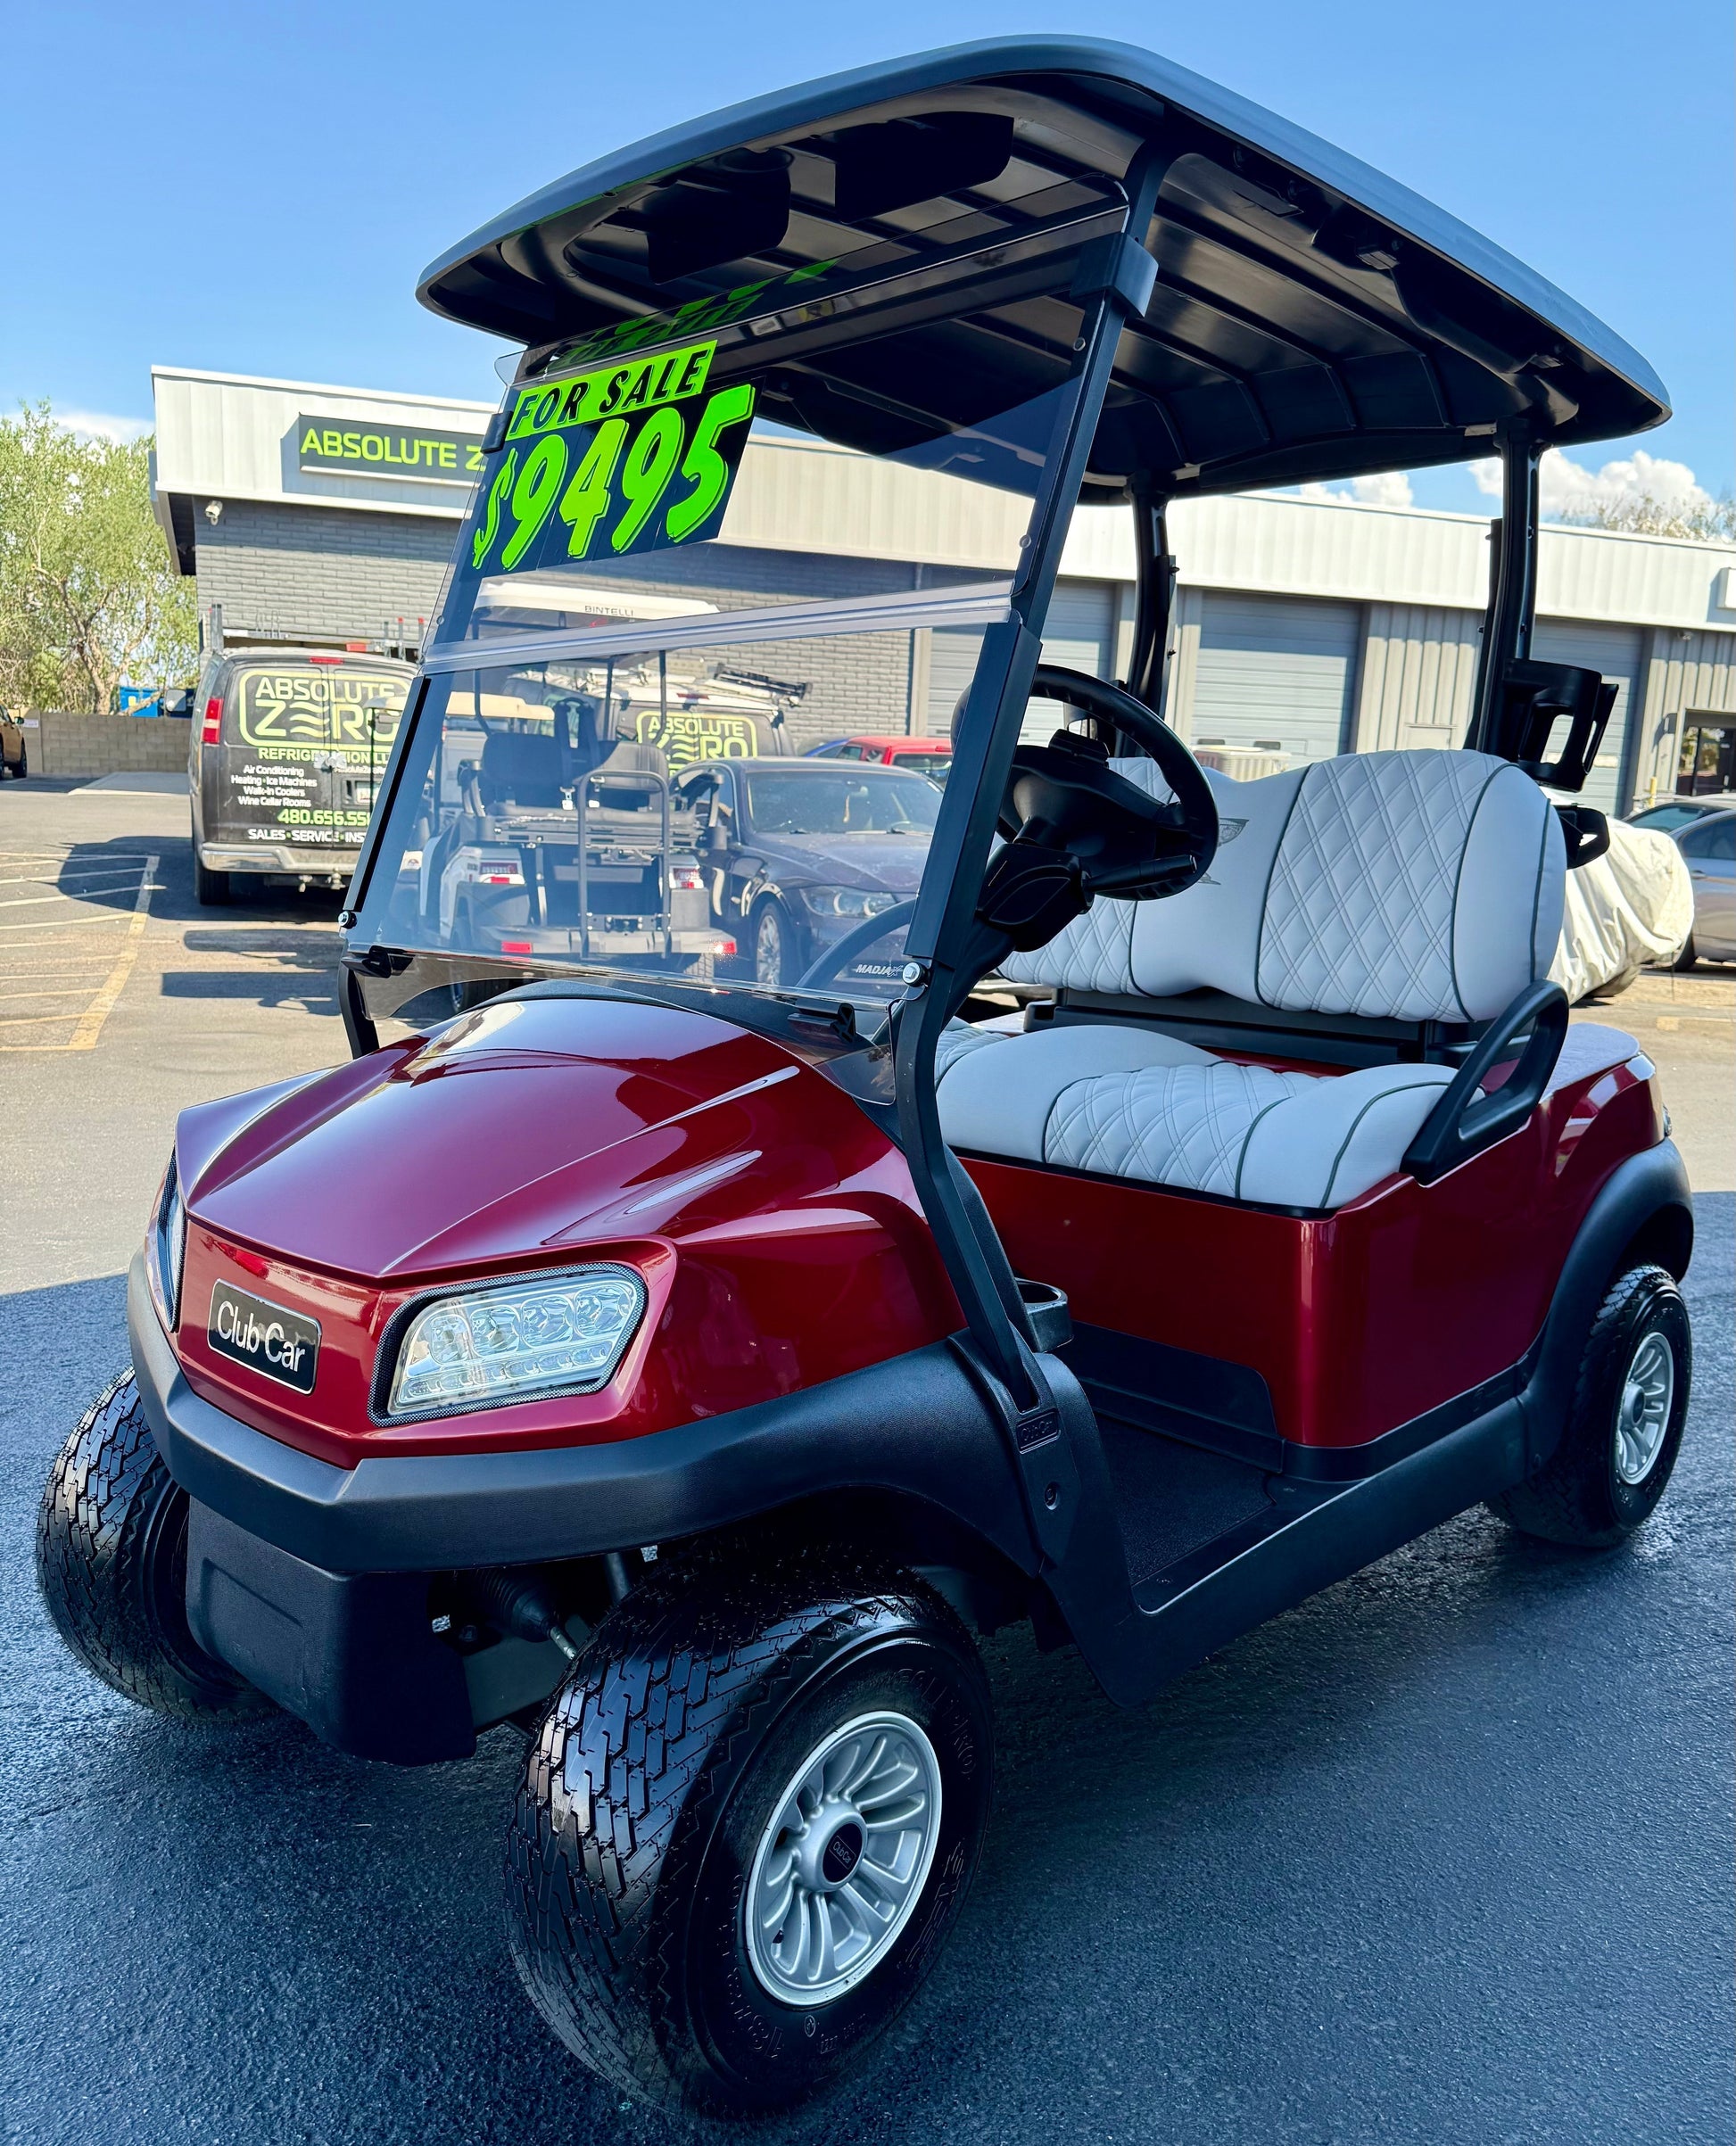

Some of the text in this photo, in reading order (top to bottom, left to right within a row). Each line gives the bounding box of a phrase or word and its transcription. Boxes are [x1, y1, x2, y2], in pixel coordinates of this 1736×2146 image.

[508, 349, 710, 435] FOR SALE
[301, 428, 458, 468] ABSOLUTE
[472, 384, 756, 569] $9495
[584, 605, 634, 617] BINTELLI
[255, 676, 395, 704] ABSOLUTE
[648, 716, 744, 738] ABSOLUTE
[258, 747, 370, 764] REFRIGION
[243, 764, 304, 778] Air Conditioning
[230, 774, 318, 788] Heating Ice Machines
[275, 786, 306, 797] Coolers
[237, 796, 312, 808] Wine Cellar Rooms
[247, 829, 286, 841] SALES
[291, 830, 340, 842] SERVICE
[855, 963, 904, 978] MADJAX
[218, 1300, 306, 1373] Club Car
